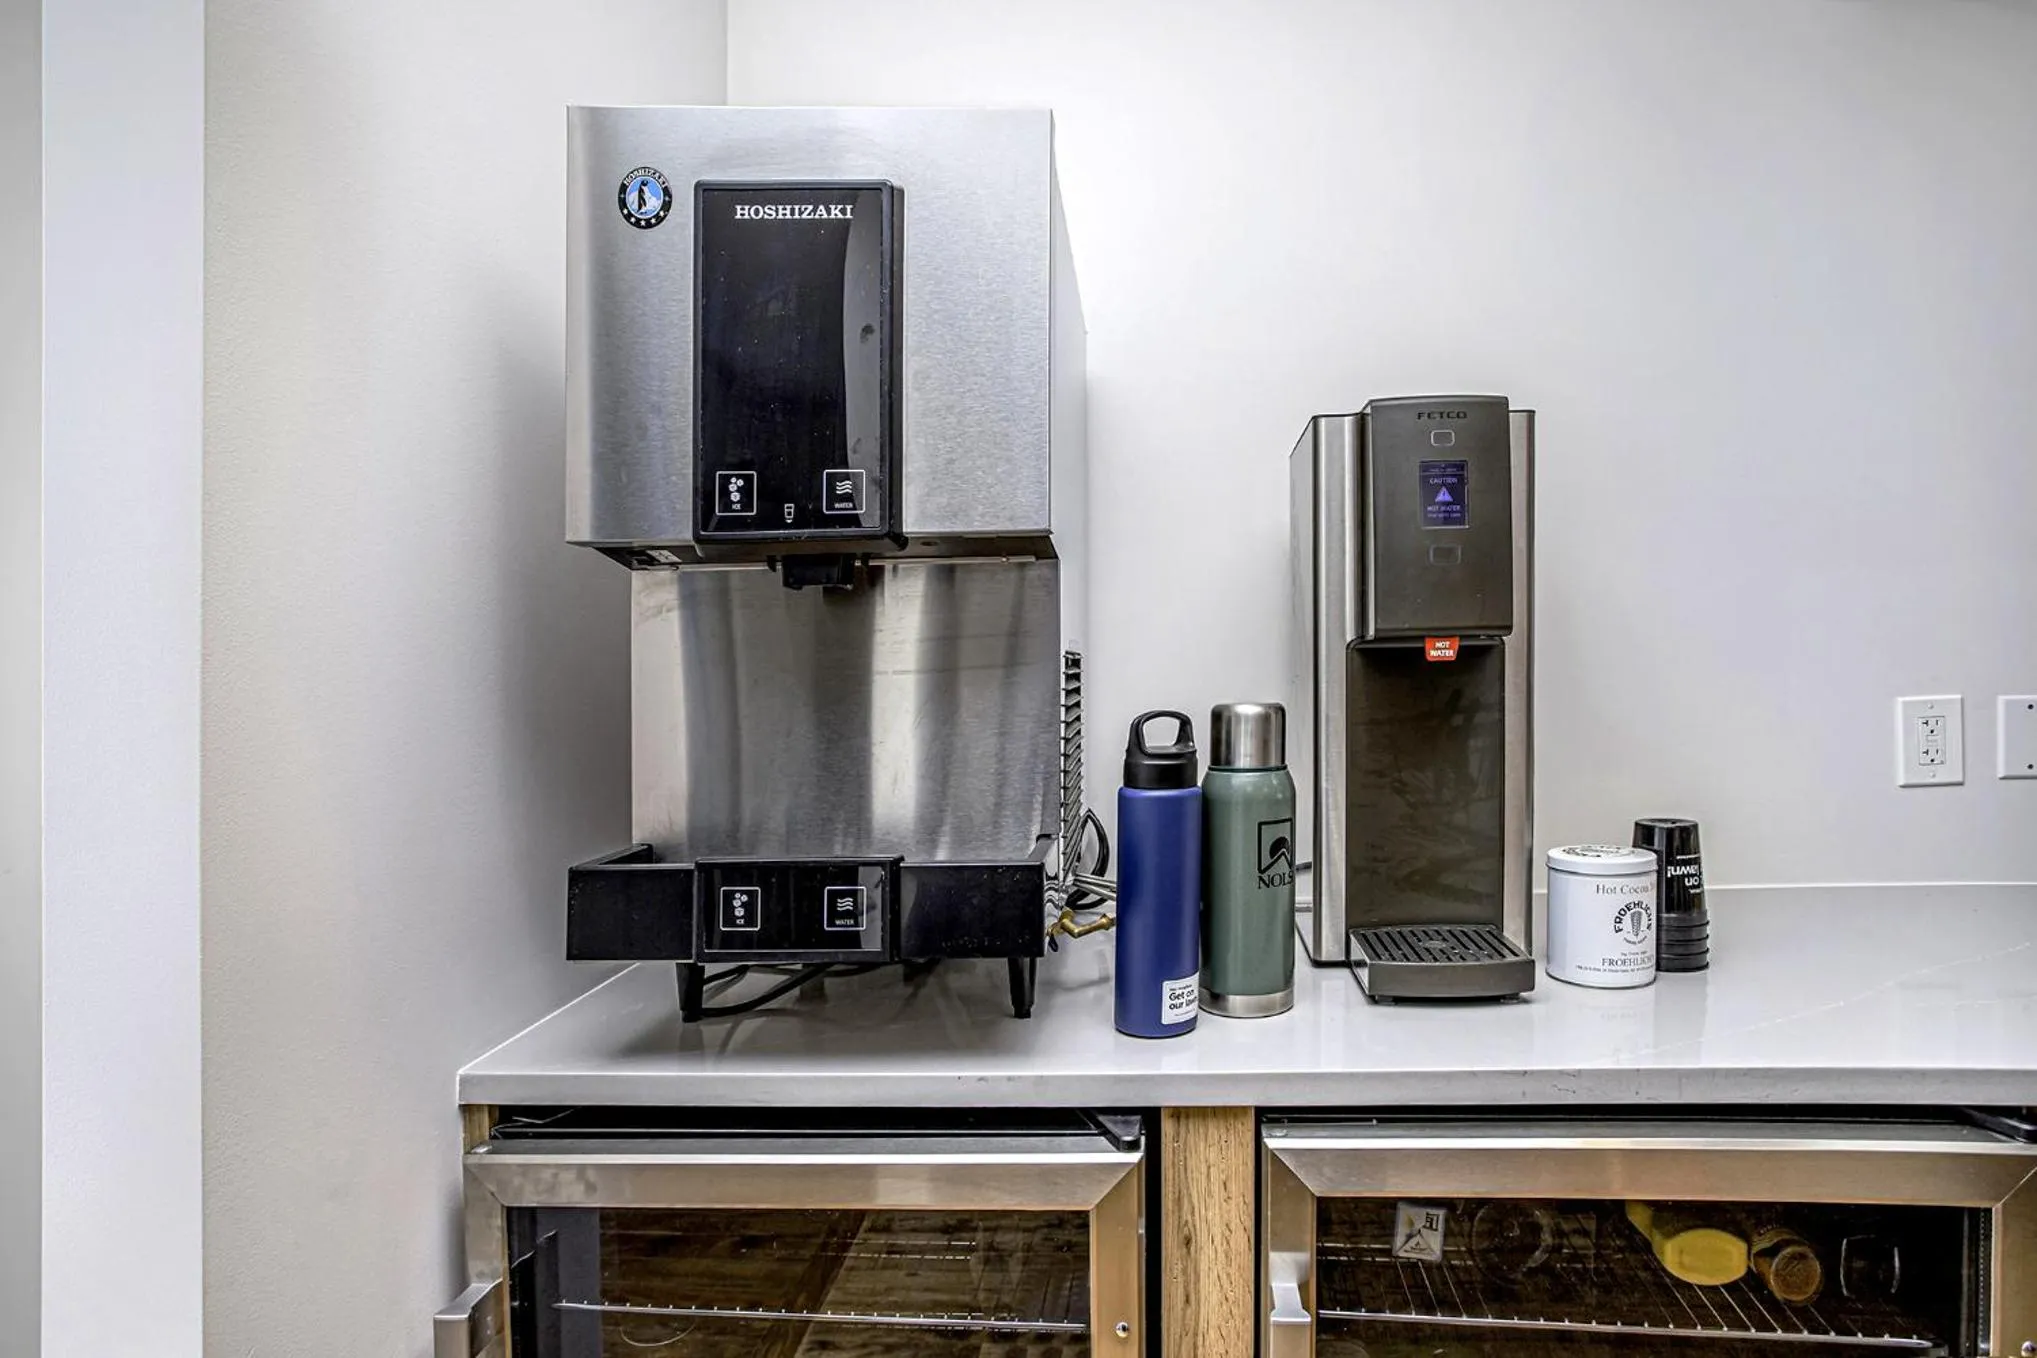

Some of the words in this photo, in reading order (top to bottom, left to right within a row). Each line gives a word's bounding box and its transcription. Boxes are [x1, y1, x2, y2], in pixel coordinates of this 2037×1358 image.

[734, 204, 854, 219] HOSHIZAKI
[1416, 411, 1468, 420] FETCO
[1434, 641, 1450, 649] HOT
[1430, 649, 1454, 657] WATER
[1596, 884, 1617, 895] Hot
[834, 918, 855, 926] WATER
[1168, 991, 1185, 1001] Get
[1168, 1001, 1185, 1010] our
